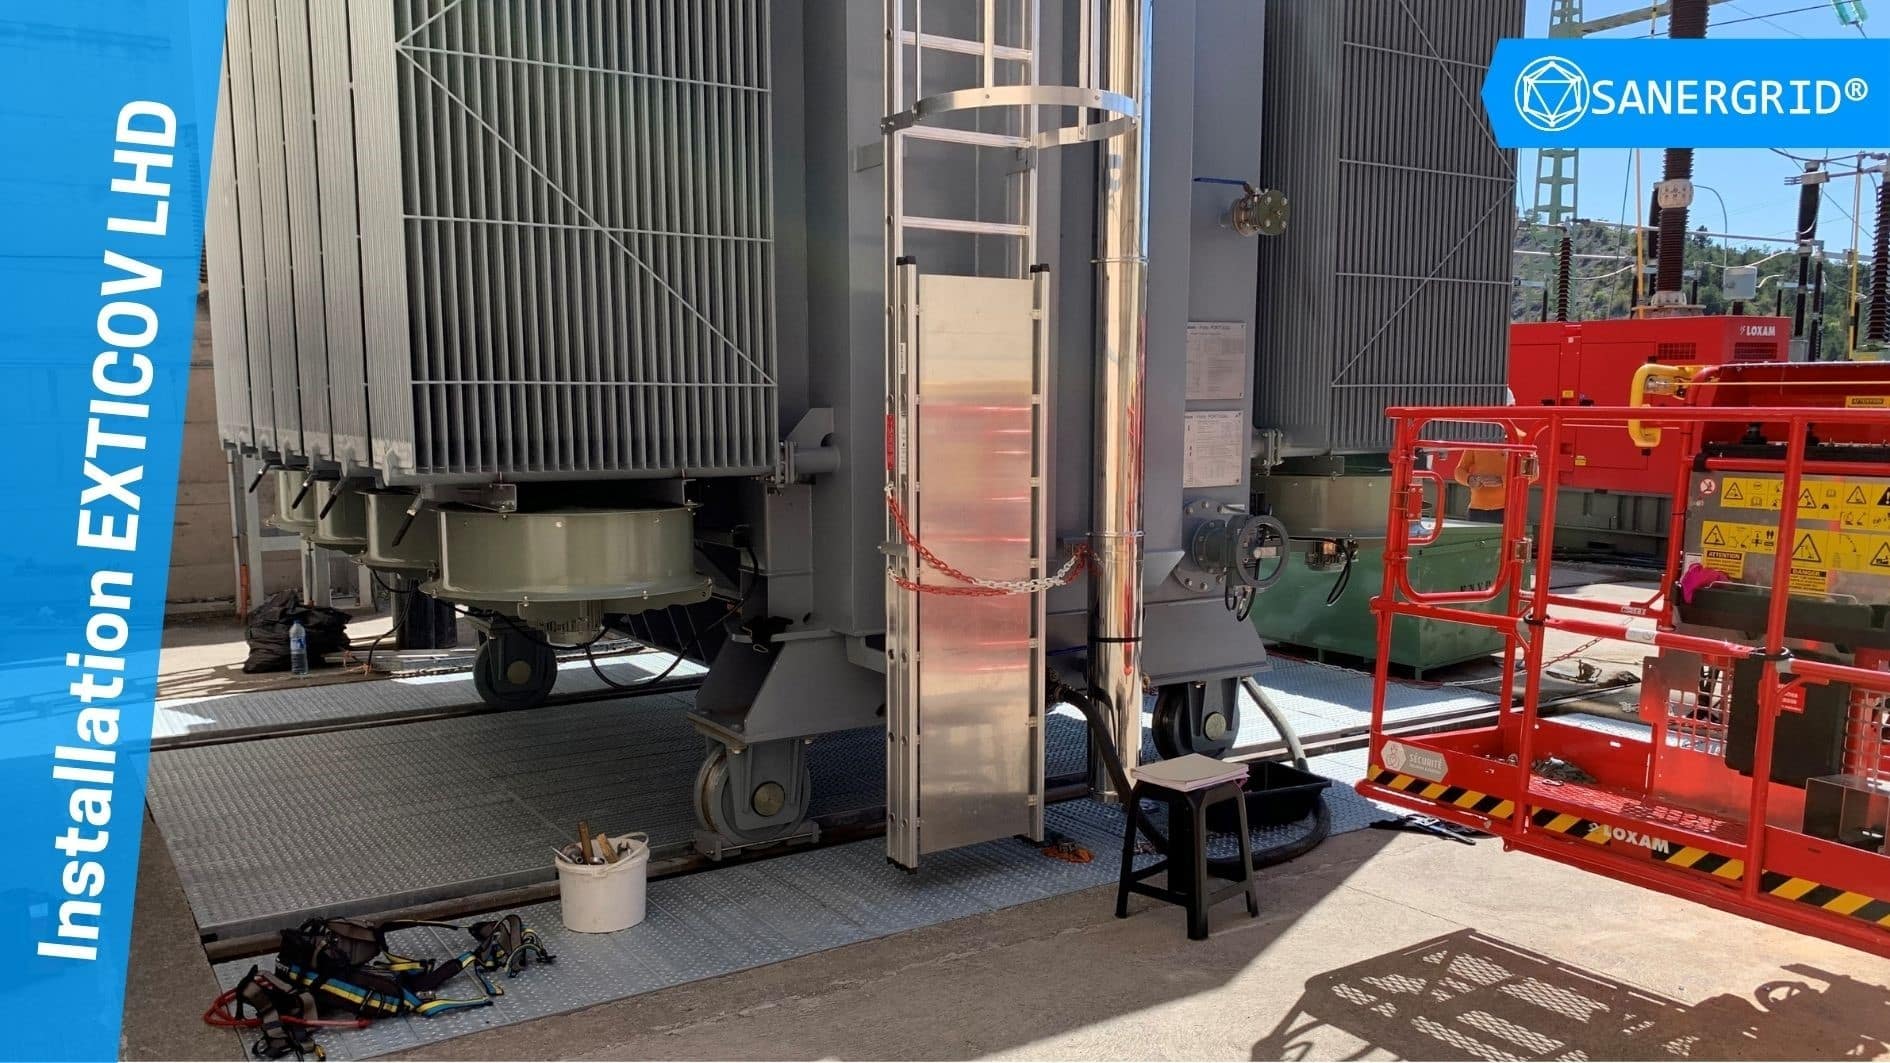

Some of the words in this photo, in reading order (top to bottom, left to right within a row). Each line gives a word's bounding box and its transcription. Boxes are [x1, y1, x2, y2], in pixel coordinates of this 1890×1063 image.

[1746, 325, 1776, 337] LOXAM
[1409, 752, 1443, 770] SÉCURITÉ
[1603, 824, 1670, 854] LOXAM
